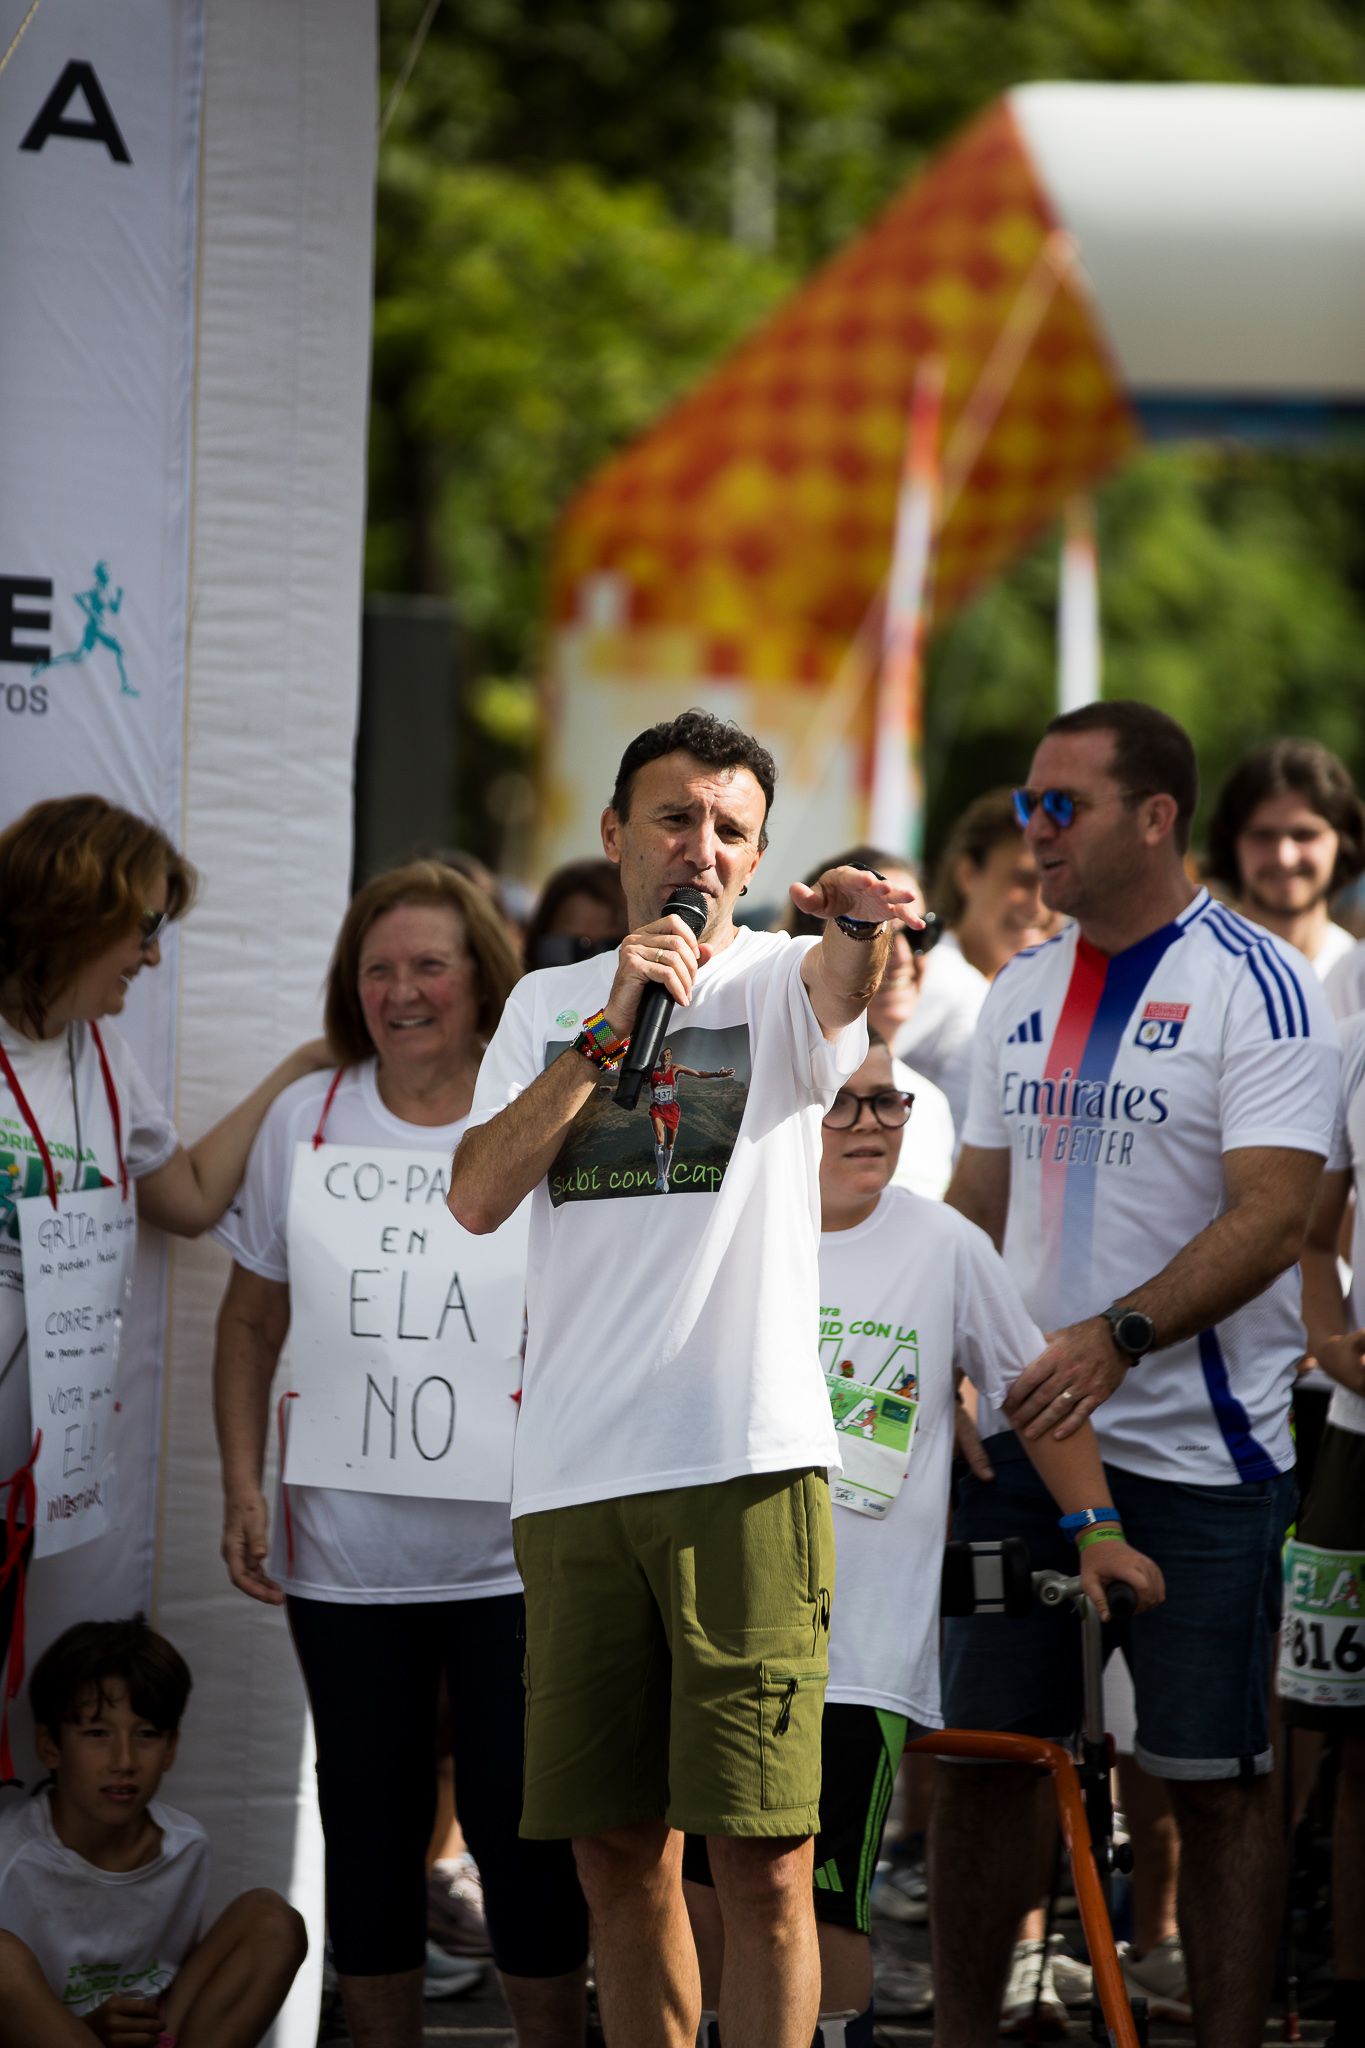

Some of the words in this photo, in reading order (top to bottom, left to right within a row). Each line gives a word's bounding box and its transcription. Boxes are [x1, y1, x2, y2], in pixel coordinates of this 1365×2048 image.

[18, 58, 134, 166] A
[0, 574, 54, 665] E
[1139, 1020, 1176, 1046] OL
[1003, 1068, 1169, 1124] Emirates
[1054, 1126, 1135, 1166] BETTER
[609, 1171, 656, 1189] con
[38, 1211, 98, 1253] GRITA
[380, 1226, 428, 1255] EN
[45, 1305, 93, 1336] CORRE
[349, 1268, 477, 1343] ELA
[820, 1321, 844, 1336] ID
[849, 1321, 892, 1338] CON
[896, 1326, 917, 1345] LA
[48, 1386, 85, 1415] VOTA
[362, 1372, 456, 1461] NO
[1292, 1560, 1362, 1610] ELA
